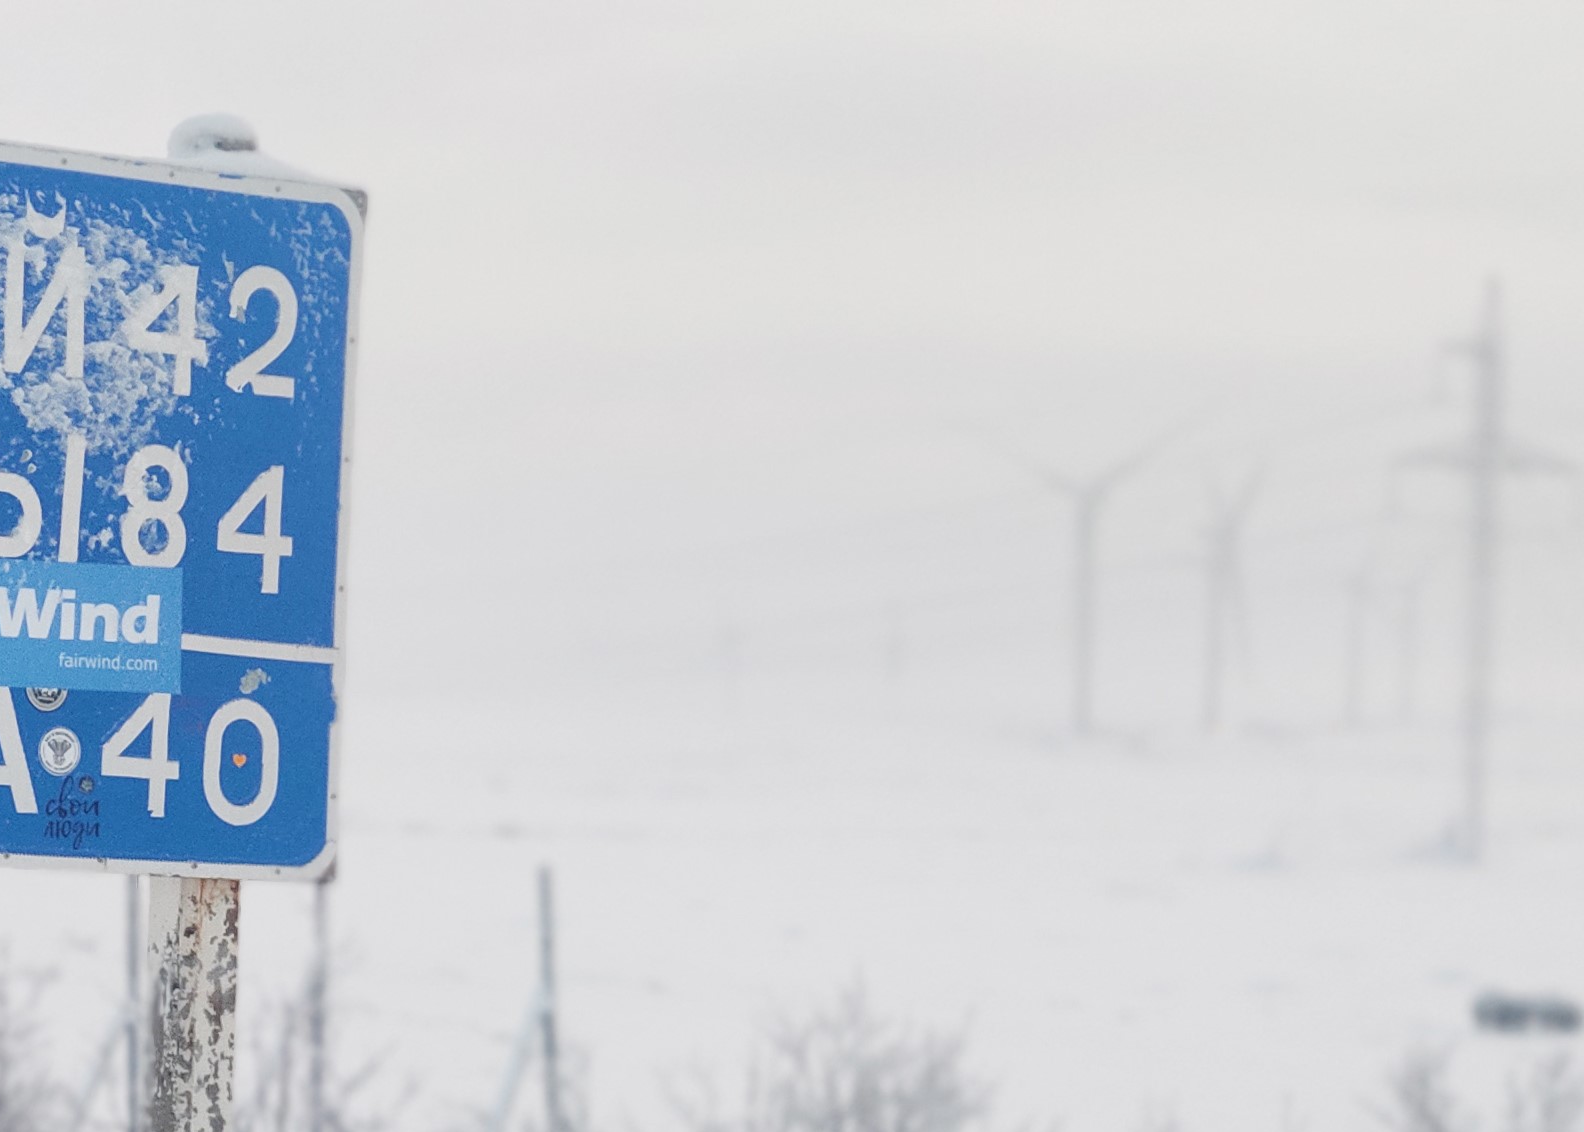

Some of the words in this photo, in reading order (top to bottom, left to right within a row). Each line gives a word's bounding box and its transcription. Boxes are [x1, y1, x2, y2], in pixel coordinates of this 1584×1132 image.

[127, 263, 300, 399] 42
[119, 443, 294, 595] 84
[58, 651, 158, 672] fairwind.com
[100, 692, 280, 827] 40
